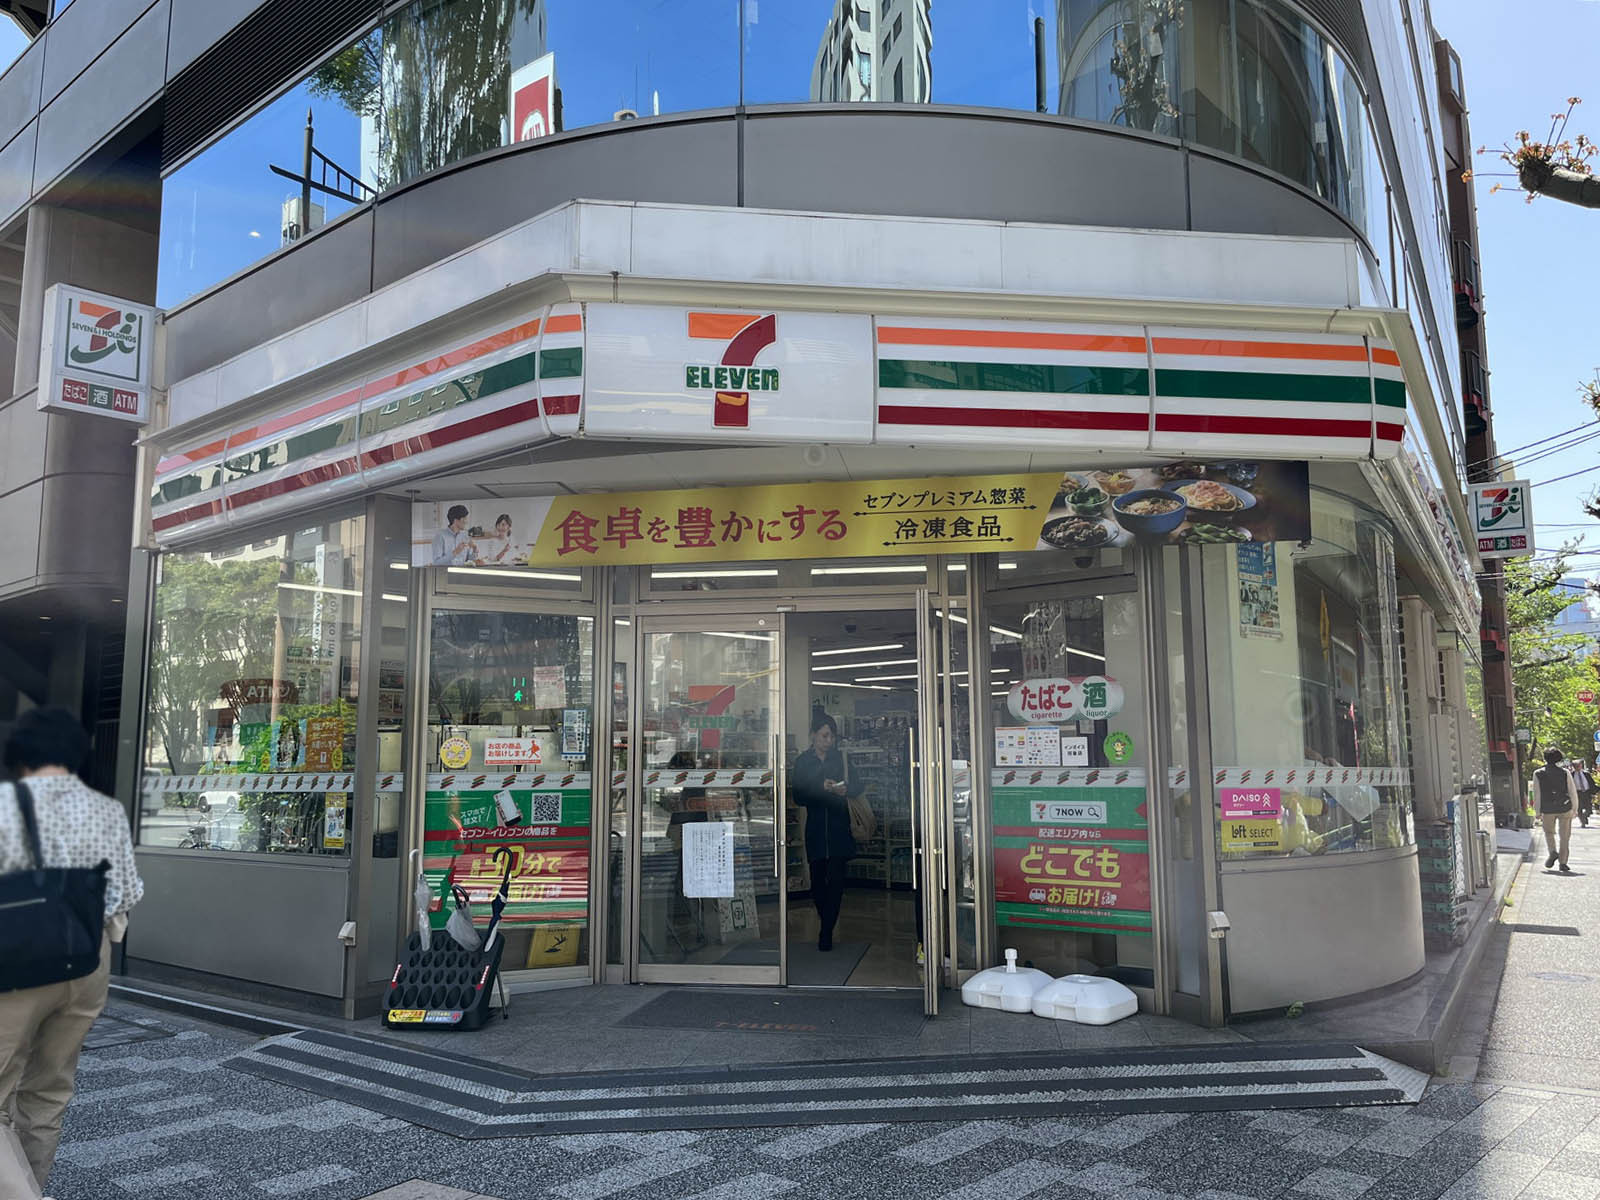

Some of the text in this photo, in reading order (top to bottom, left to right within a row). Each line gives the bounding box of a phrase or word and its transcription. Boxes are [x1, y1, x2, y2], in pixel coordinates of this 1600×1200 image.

[64, 383, 108, 405] たばこ 酒
[114, 393, 137, 411] ATM
[864, 486, 1027, 508] セブンプレミアム惣菜
[554, 504, 849, 557] 食卓を豊かにする
[894, 514, 1002, 540] 冷凍食品
[1480, 540, 1494, 550] ATM
[1021, 682, 1107, 712] たばこ 酒
[1031, 710, 1108, 720] cigarette liquor
[1232, 794, 1261, 803] DAISO
[1055, 808, 1083, 816] 7NOW
[1249, 829, 1273, 838] SELECT
[1020, 845, 1121, 879] どこでも
